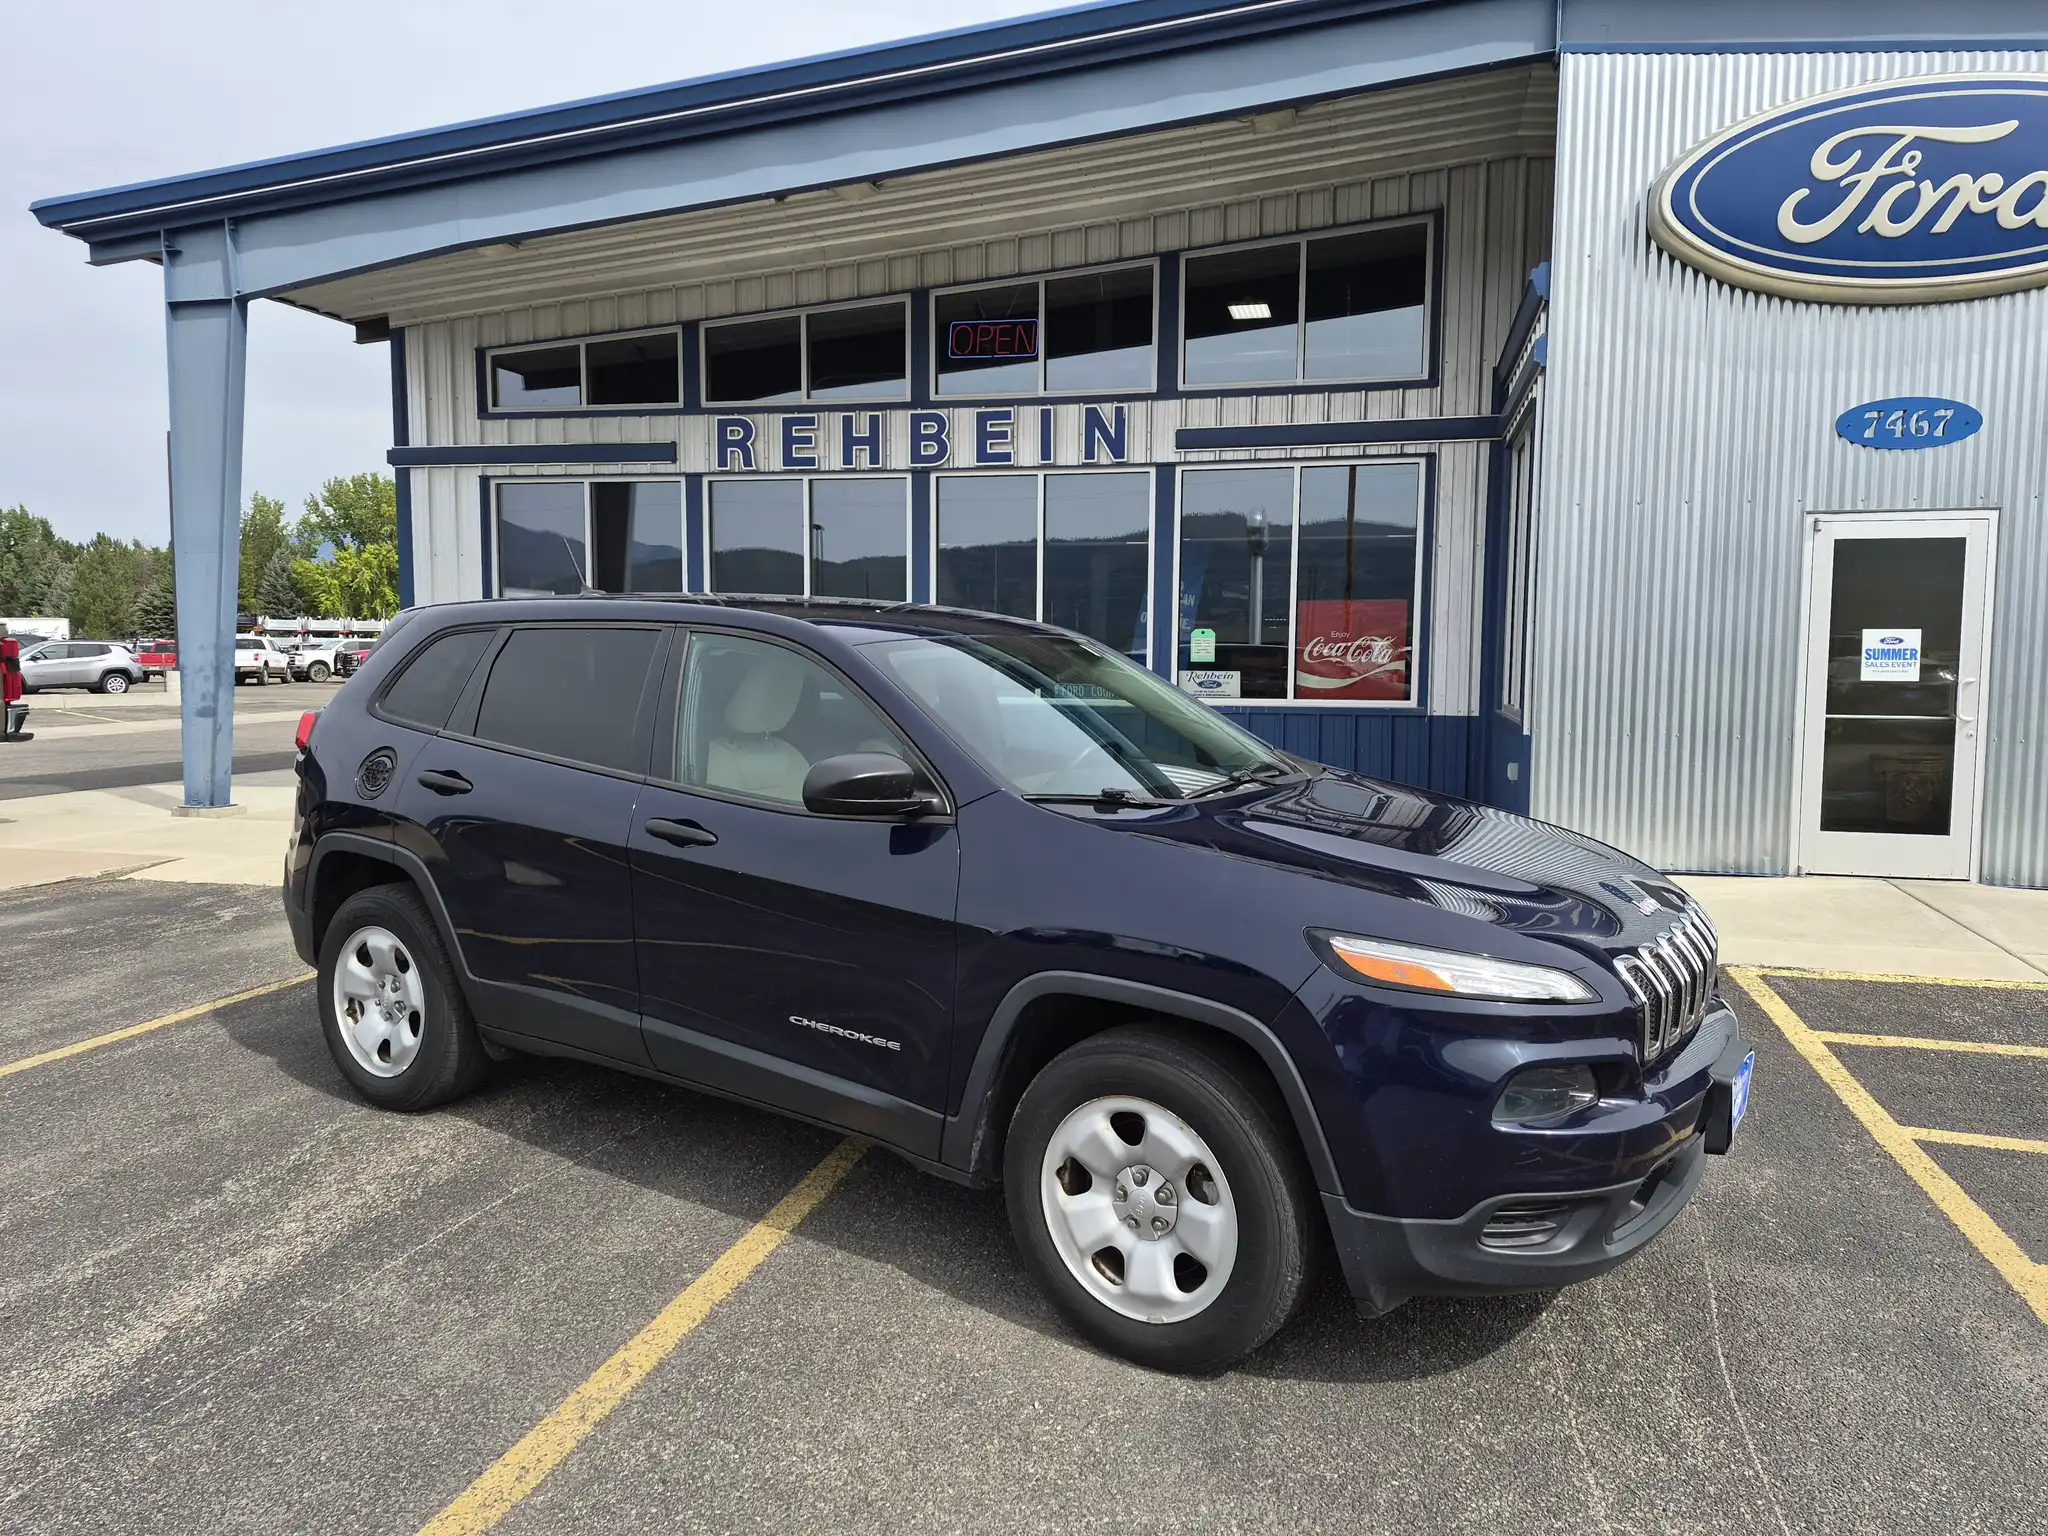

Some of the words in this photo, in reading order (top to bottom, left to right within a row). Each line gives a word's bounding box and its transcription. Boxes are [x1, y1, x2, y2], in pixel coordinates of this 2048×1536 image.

[952, 323, 1036, 355] OPEN
[714, 403, 1129, 472] REHBEIN
[1863, 407, 1955, 440] 7467
[1331, 630, 1350, 638] Enjoy
[1864, 648, 1919, 661] SUMMER
[1186, 672, 1234, 685] Rehbein
[789, 1015, 901, 1051] CHEROKEE
